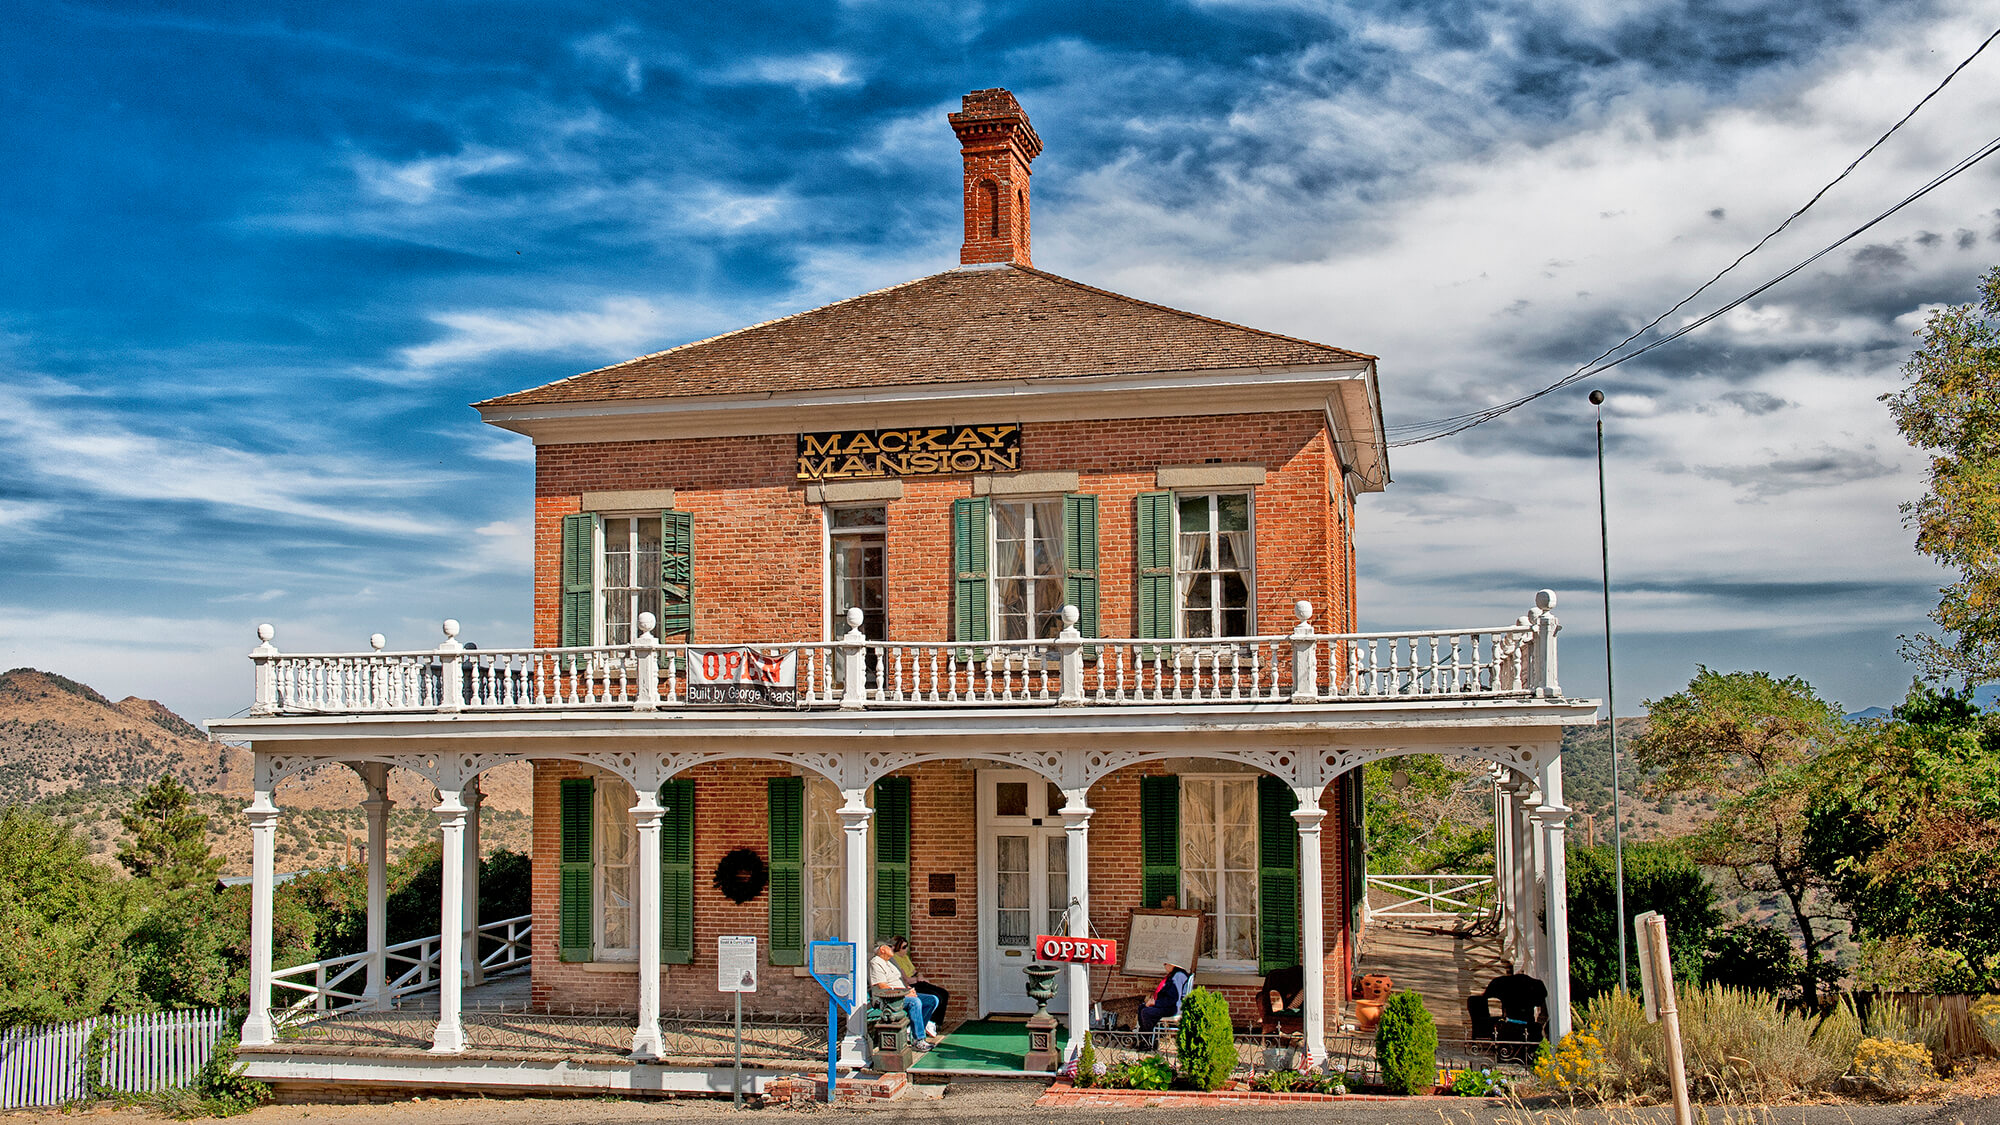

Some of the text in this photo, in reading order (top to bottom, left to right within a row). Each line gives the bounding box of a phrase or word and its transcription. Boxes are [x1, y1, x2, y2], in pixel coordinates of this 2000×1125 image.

[803, 426, 1017, 456] MACKAY
[797, 447, 1020, 479] MANSION
[702, 651, 785, 684] OPEN
[689, 686, 711, 700] Built
[714, 687, 726, 703] by
[728, 686, 761, 703] George
[1043, 940, 1109, 961] OPEN
